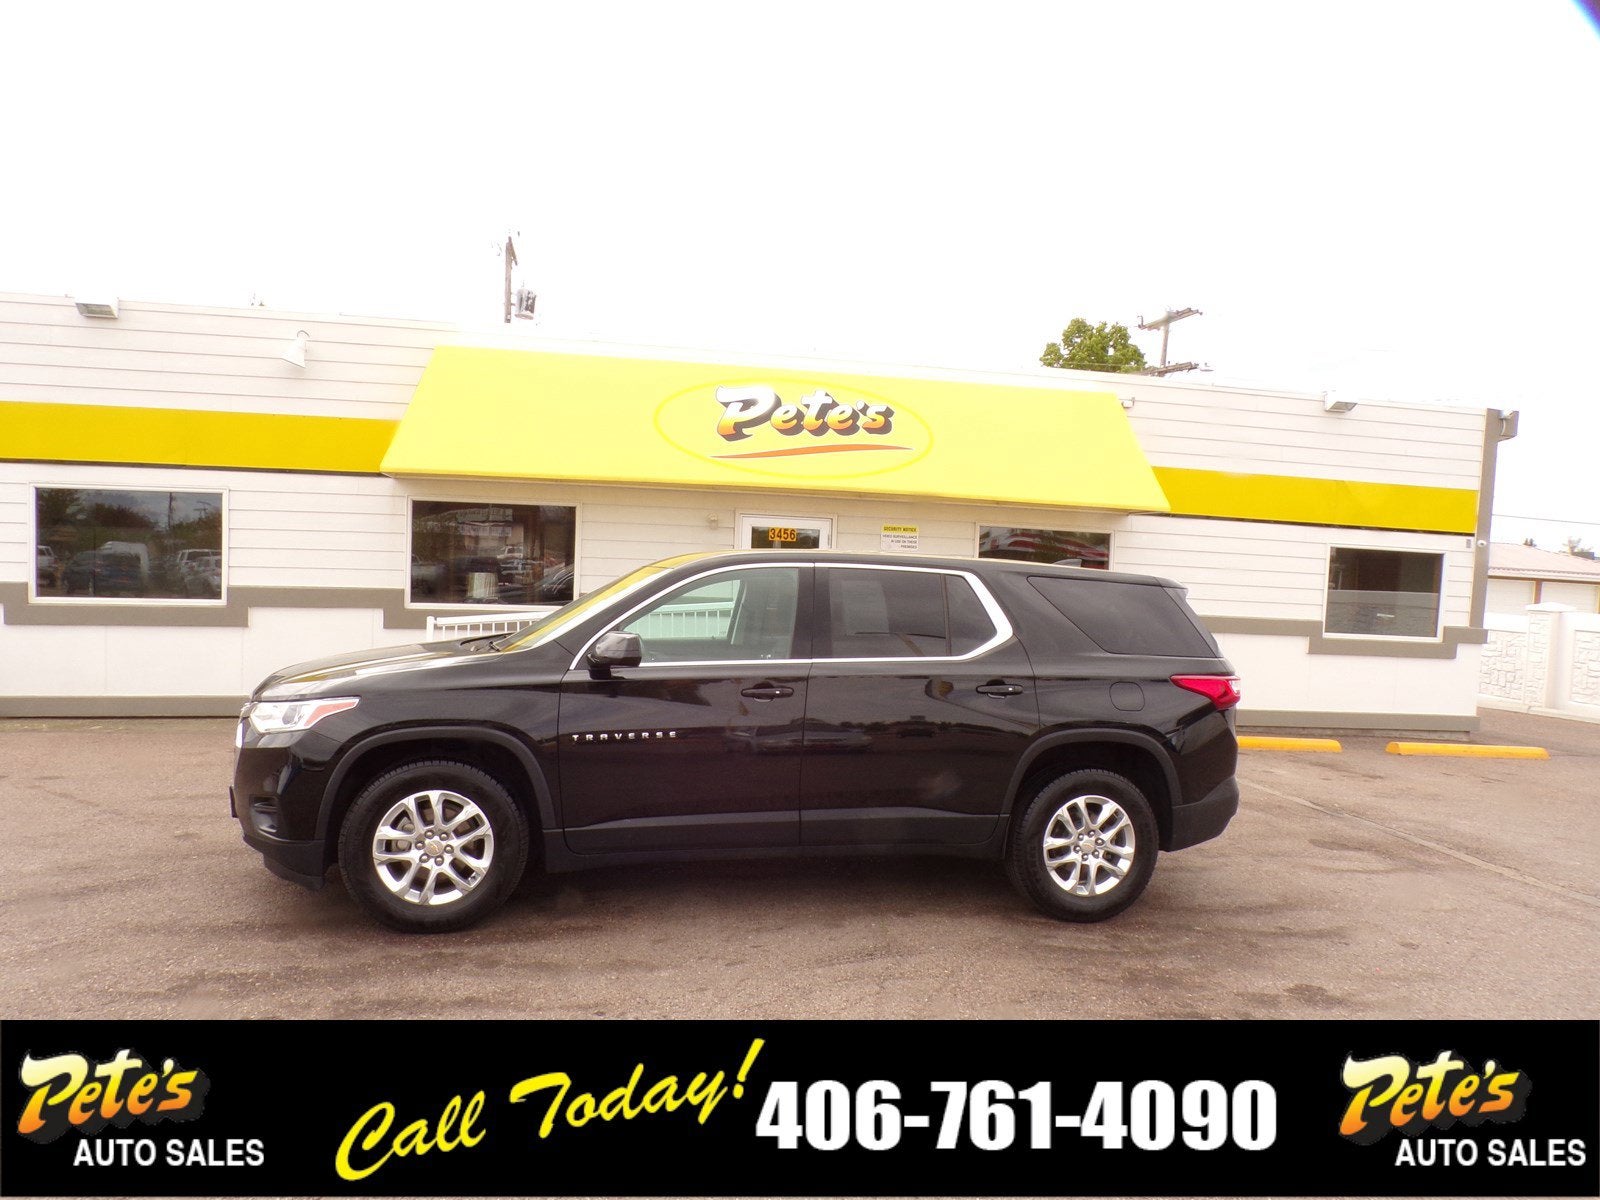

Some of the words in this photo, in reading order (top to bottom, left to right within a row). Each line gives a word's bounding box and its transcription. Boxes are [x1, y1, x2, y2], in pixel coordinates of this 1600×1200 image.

[715, 385, 895, 441] Pete's
[769, 528, 796, 541] 3456
[572, 731, 677, 741] TRAVERSE
